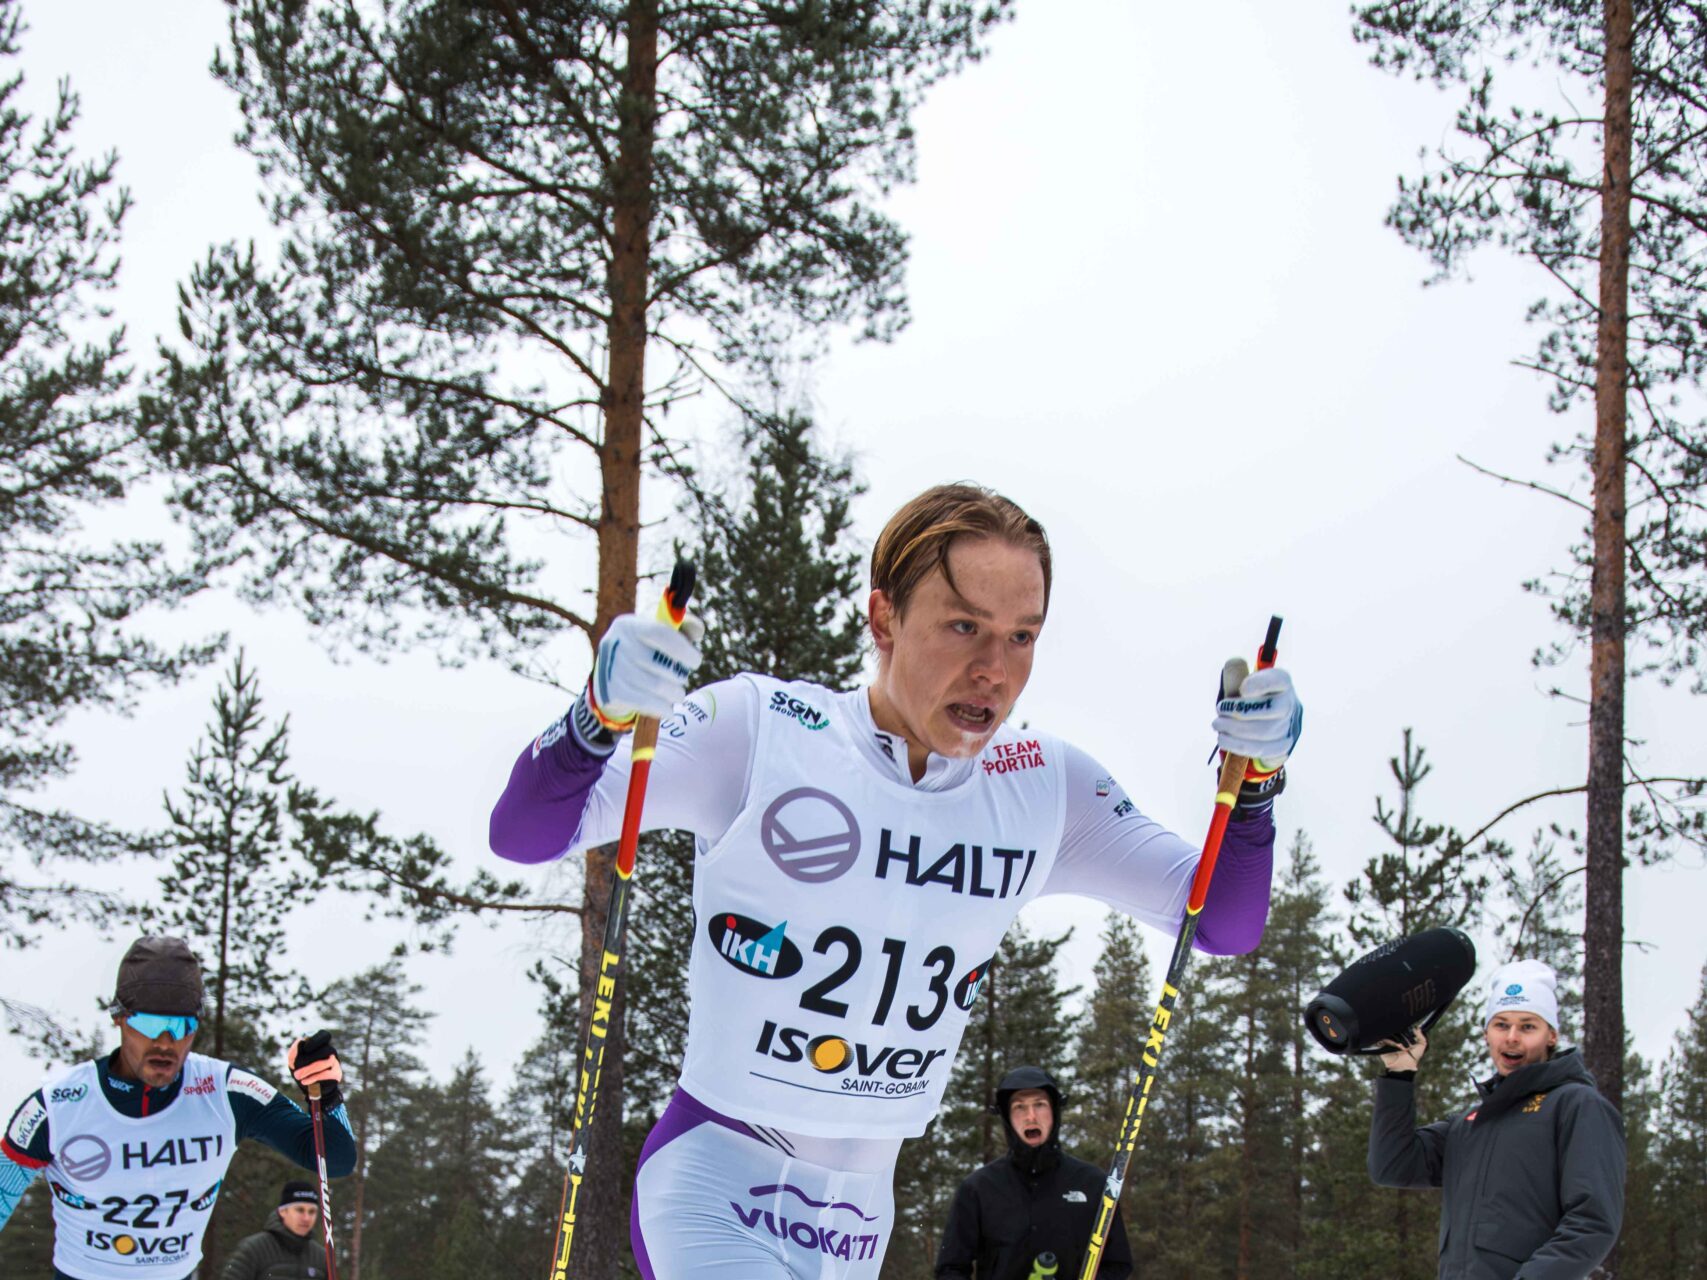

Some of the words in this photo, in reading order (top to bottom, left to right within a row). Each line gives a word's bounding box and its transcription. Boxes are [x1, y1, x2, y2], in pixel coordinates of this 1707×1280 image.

[769, 704, 797, 719] GROUP
[771, 688, 822, 725] SGN
[993, 740, 1041, 759] TEAM
[875, 828, 1037, 899] HALTI
[591, 949, 620, 1039] LEKI
[798, 925, 955, 1032] 213
[1141, 981, 1179, 1068] LEKI
[51, 1087, 83, 1100] SGN
[840, 1077, 930, 1095] SAINT-GOBAIN
[122, 1134, 223, 1170] HALTI
[102, 1188, 189, 1229] 227
